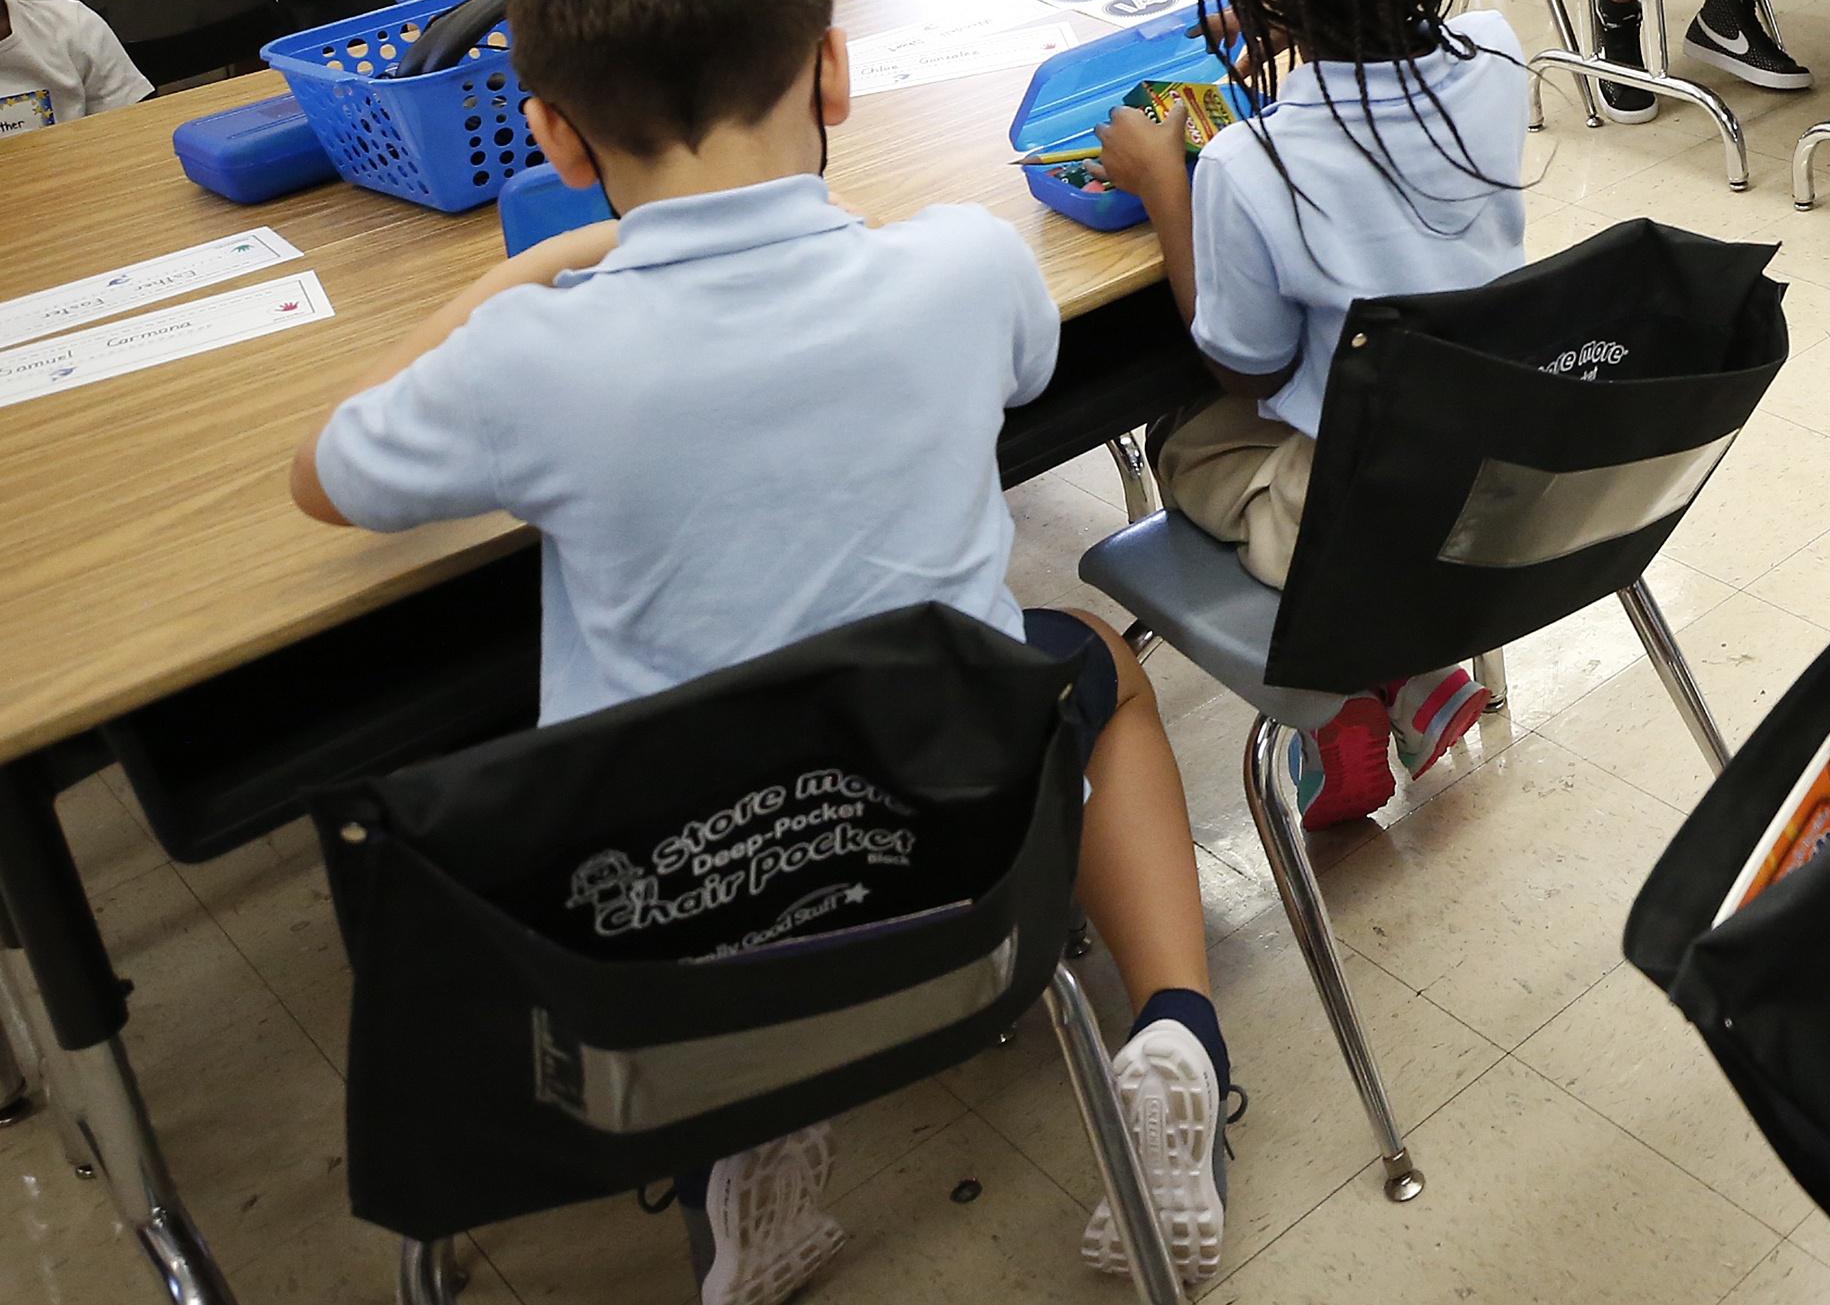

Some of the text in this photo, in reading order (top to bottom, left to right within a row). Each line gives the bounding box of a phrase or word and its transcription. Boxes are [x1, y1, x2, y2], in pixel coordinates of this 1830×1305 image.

[0, 120, 24, 132] ther
[106, 318, 193, 348] Carmona
[652, 785, 787, 875] Store
[693, 800, 865, 877] Deep-Pocket
[595, 823, 916, 936] Chair Pocket
